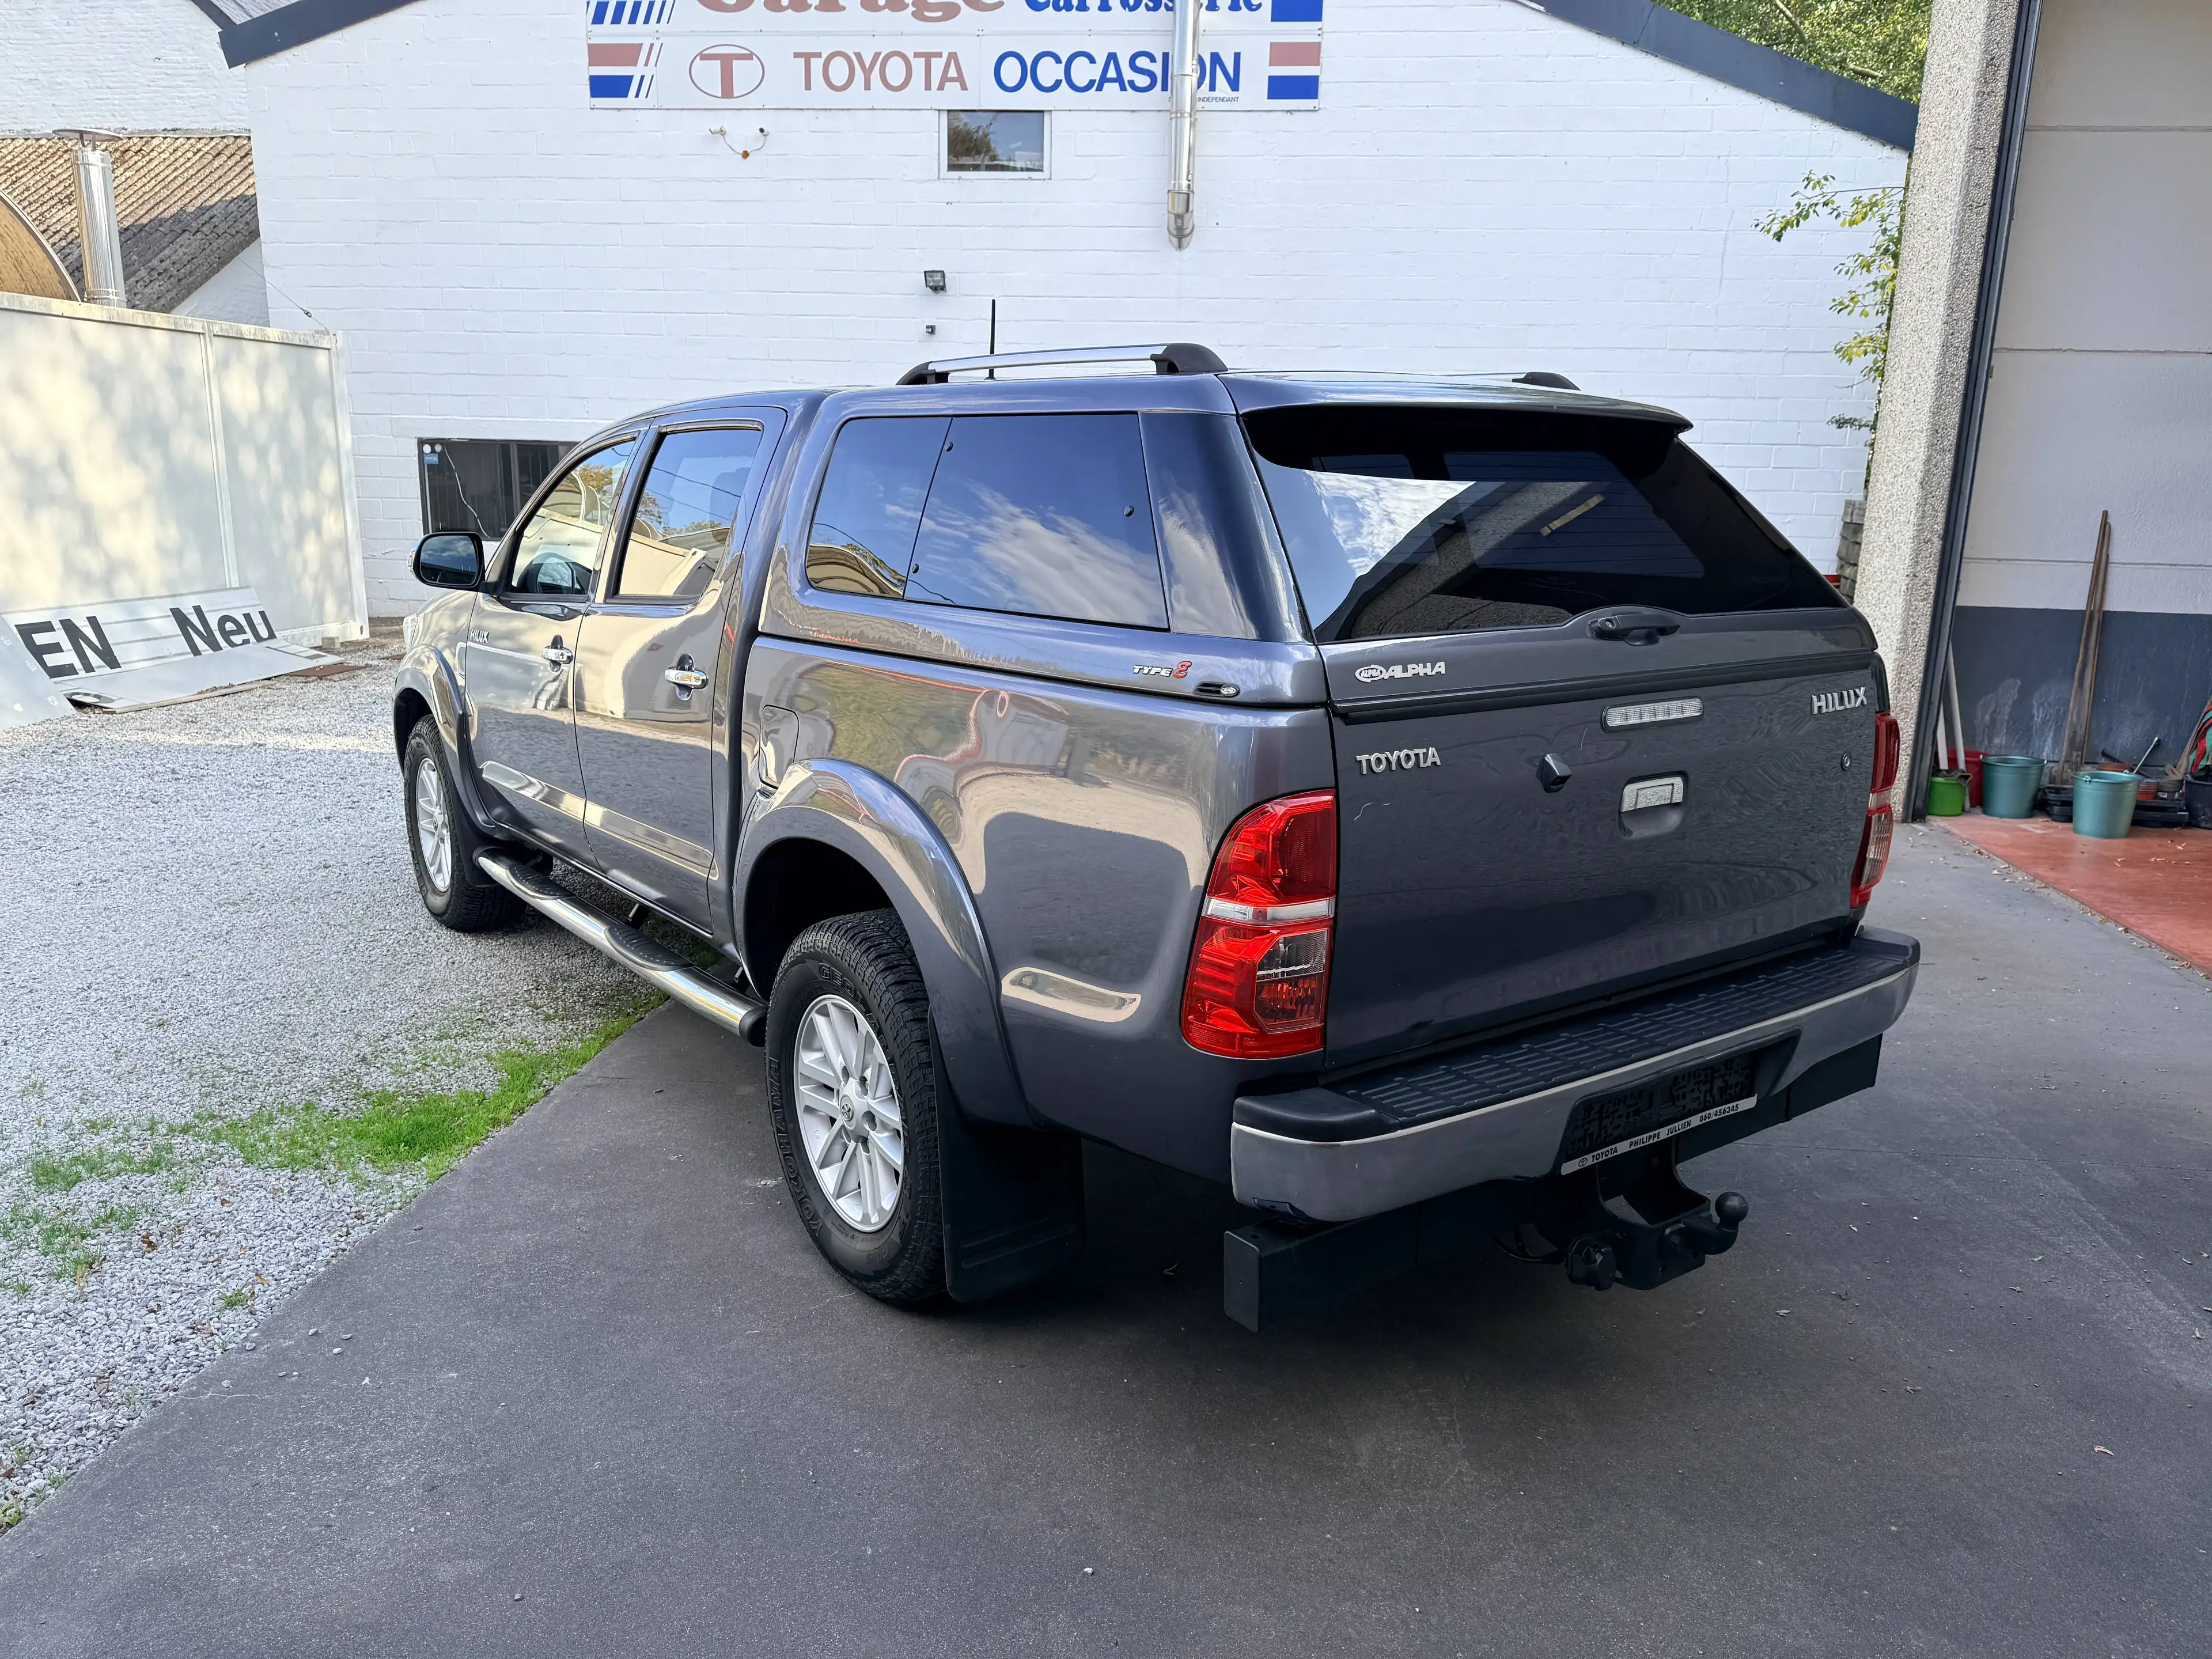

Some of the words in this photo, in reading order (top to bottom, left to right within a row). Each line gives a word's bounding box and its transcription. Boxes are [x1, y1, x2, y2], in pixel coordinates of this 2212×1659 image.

[793, 51, 968, 92] TOYOTA
[994, 51, 1241, 92] OCCASIN
[14, 616, 122, 679] EN
[169, 605, 276, 657] Neu
[470, 629, 489, 643] HILUX
[1132, 665, 1173, 677] TYPE
[1384, 662, 1445, 679] ALPHA
[1812, 687, 1868, 714] HILUX
[1355, 747, 1441, 775] TOYOTA
[1592, 1146, 1618, 1162] TOYOTA
[1629, 1131, 1661, 1149] PHILIPPE
[1666, 1119, 1692, 1136] JULLIEN
[1699, 1104, 1739, 1123] 060/456345
